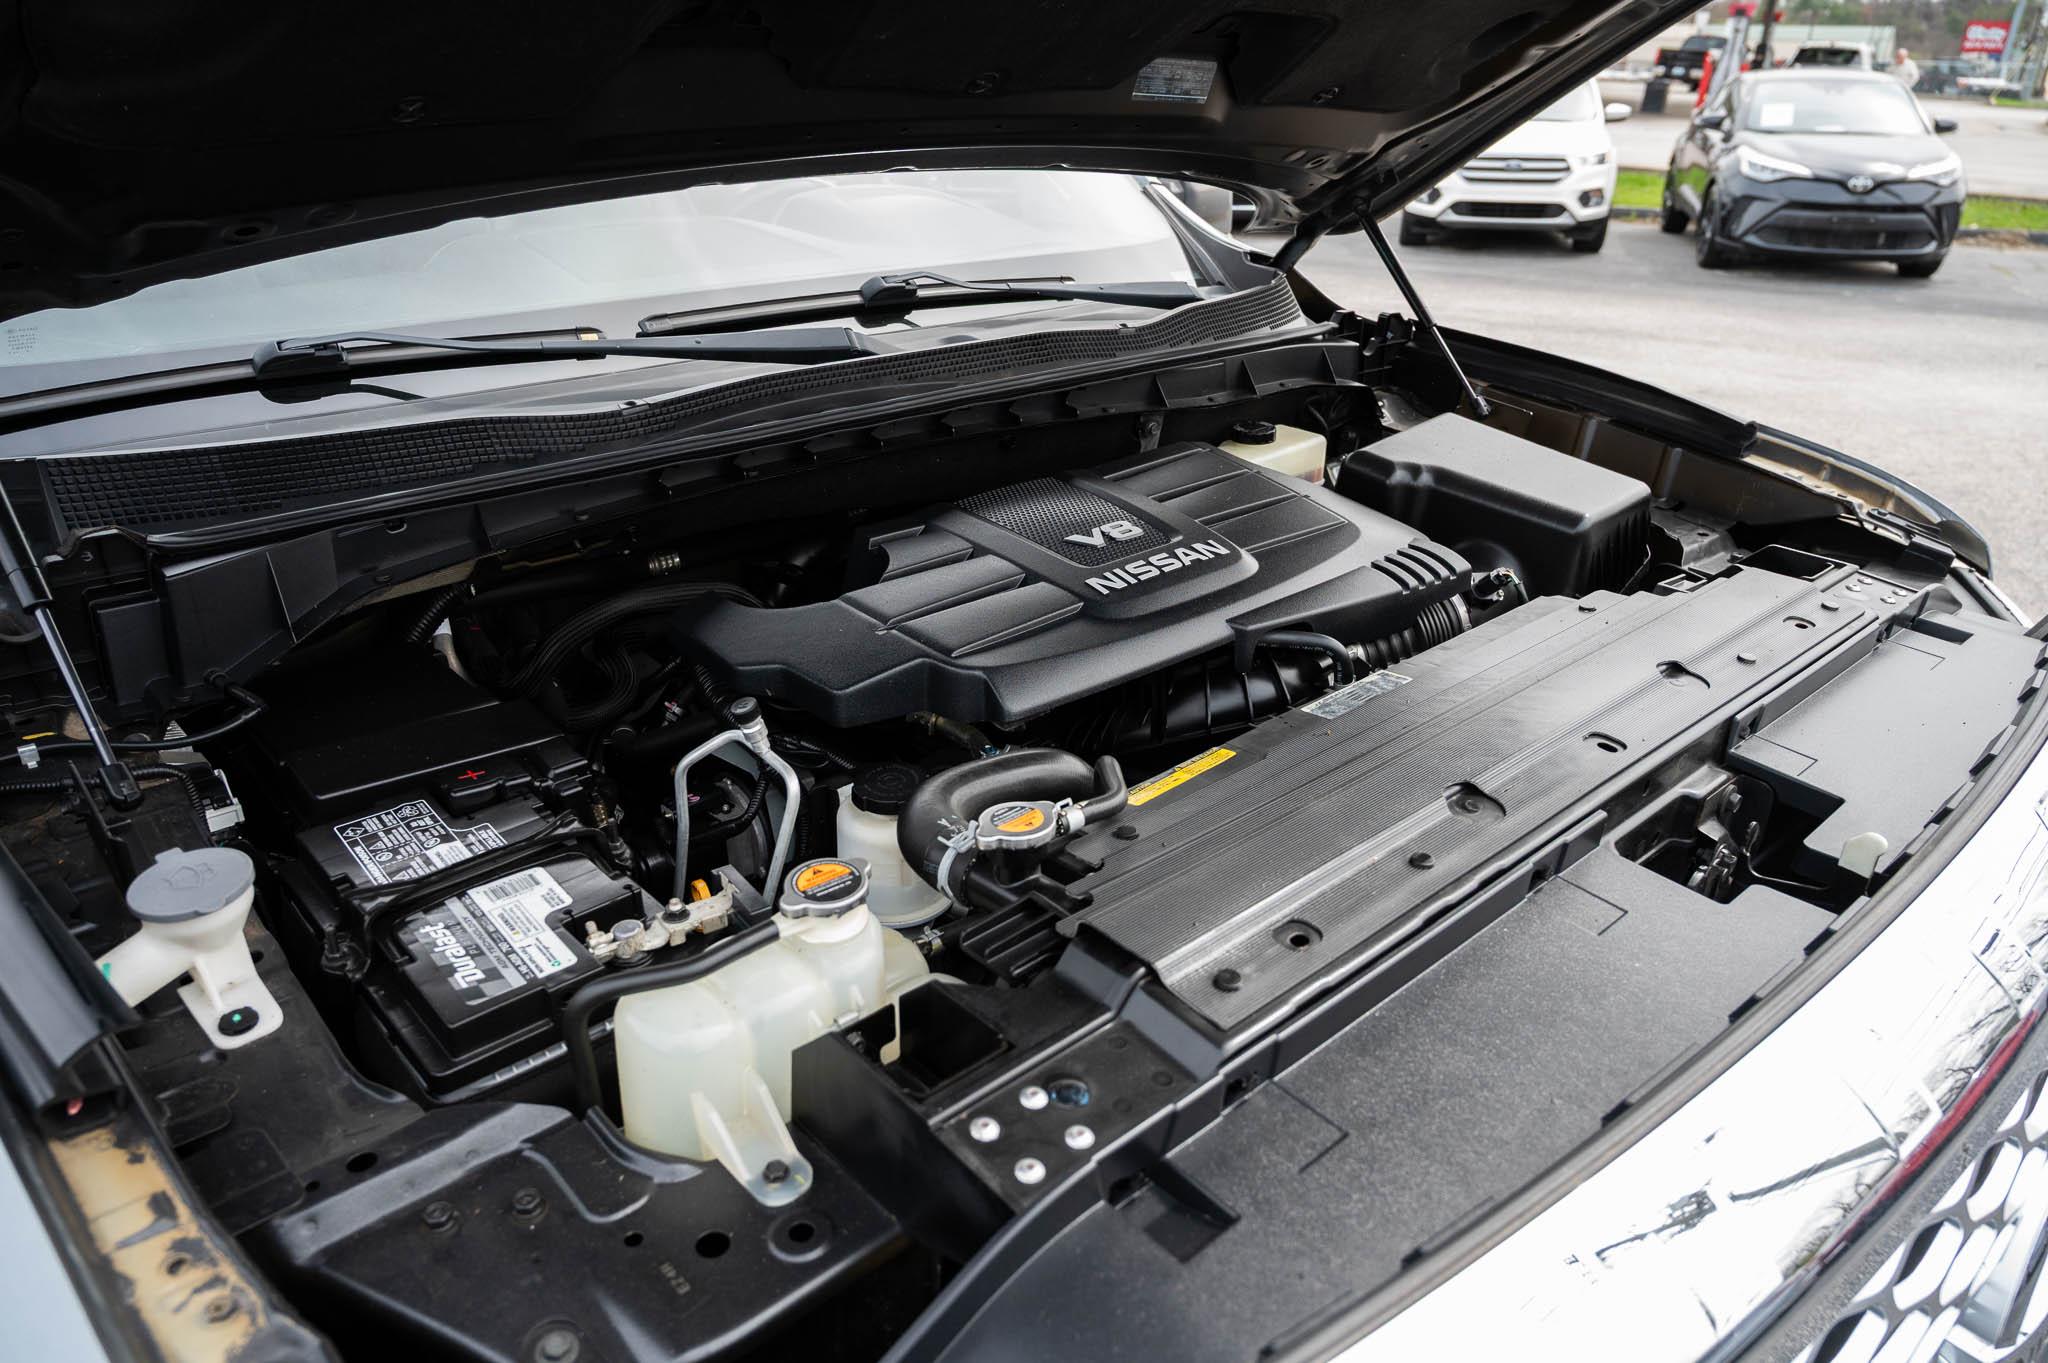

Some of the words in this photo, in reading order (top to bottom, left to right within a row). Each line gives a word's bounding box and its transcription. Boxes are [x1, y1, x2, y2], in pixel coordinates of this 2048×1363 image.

[1064, 520, 1144, 548] V8
[1085, 540, 1231, 595] NISSAN
[418, 921, 487, 989] Duralast
